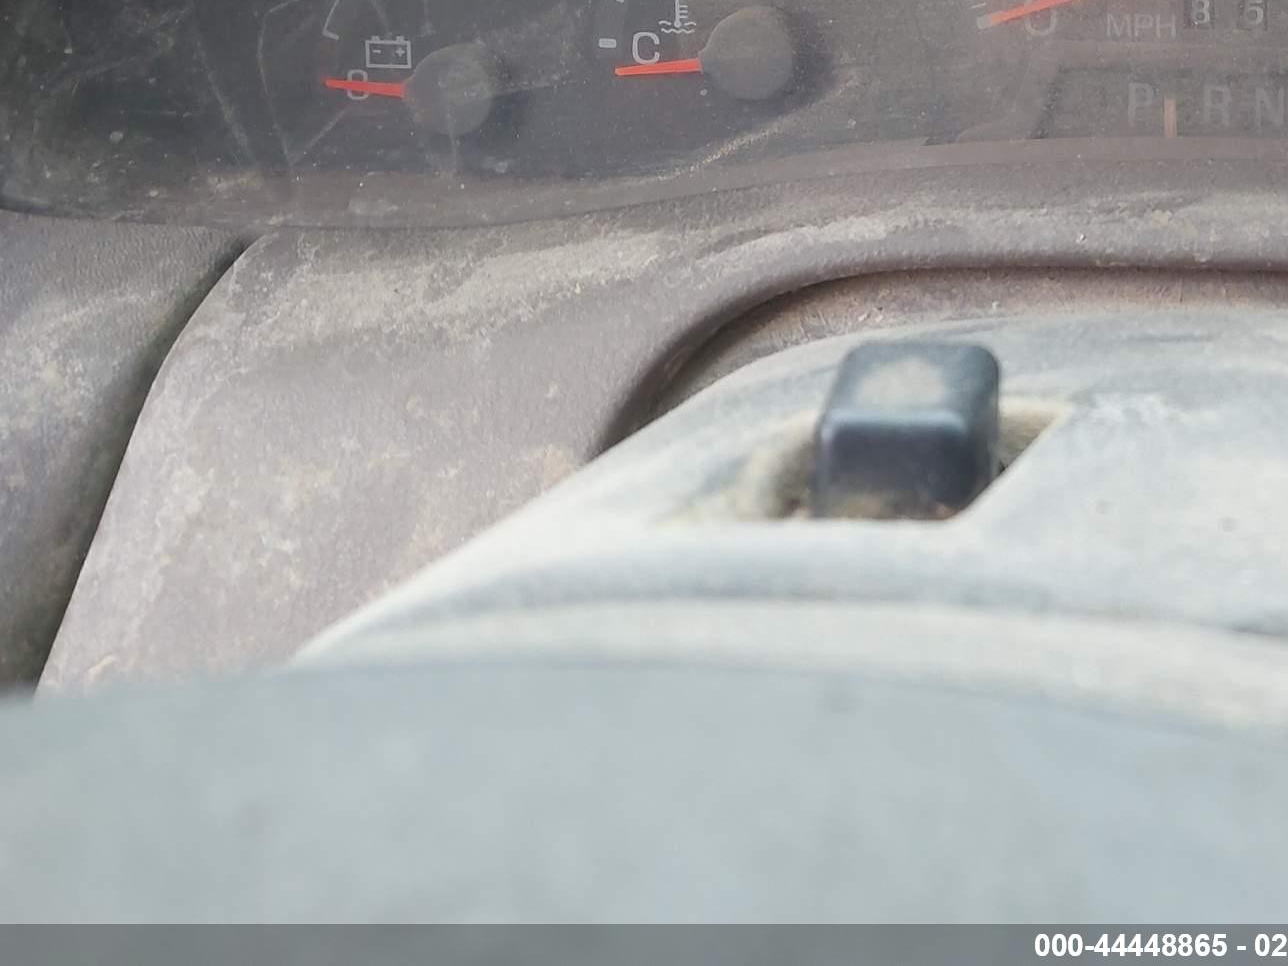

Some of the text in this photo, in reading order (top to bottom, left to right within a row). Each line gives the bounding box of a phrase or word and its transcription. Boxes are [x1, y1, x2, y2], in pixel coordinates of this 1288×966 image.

[1105, 11, 1178, 40] MPH
[631, 31, 661, 65] C
[1127, 81, 1156, 128] P
[1202, 83, 1231, 130] R
[1254, 85, 1284, 131] N
